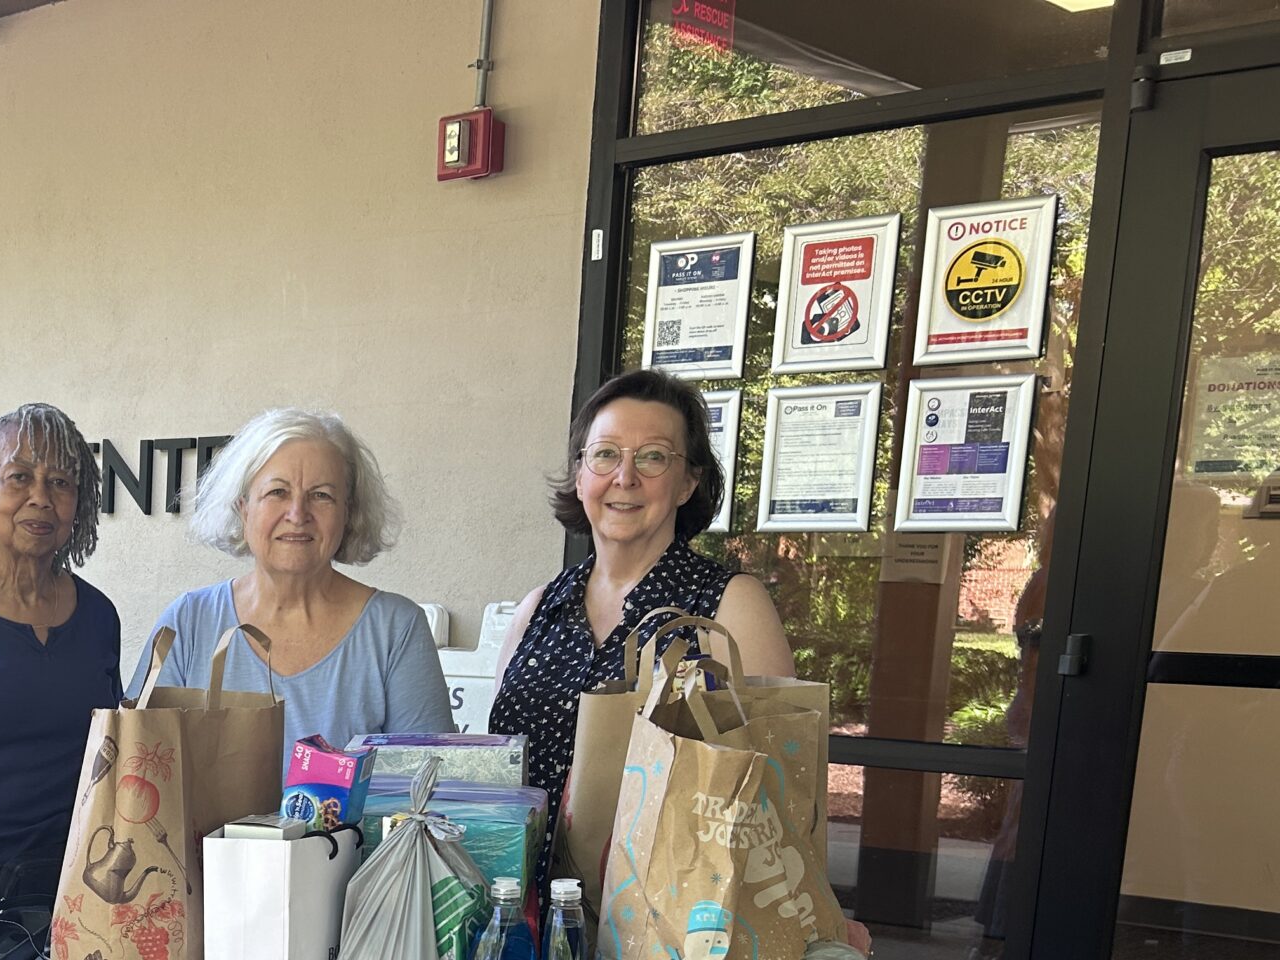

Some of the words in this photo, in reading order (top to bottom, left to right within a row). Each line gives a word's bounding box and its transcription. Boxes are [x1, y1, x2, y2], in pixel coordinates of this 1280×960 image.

[694, 2, 729, 28] RESCUE
[969, 217, 1028, 235] NOTICE
[815, 248, 837, 256] Taking
[839, 245, 862, 254] photos
[836, 253, 857, 261] videos
[821, 260, 855, 271] permitted
[959, 288, 1007, 304] CCTV
[968, 303, 1001, 311] OPERATION
[970, 405, 1003, 414] InterAct
[294, 745, 304, 759] 40
